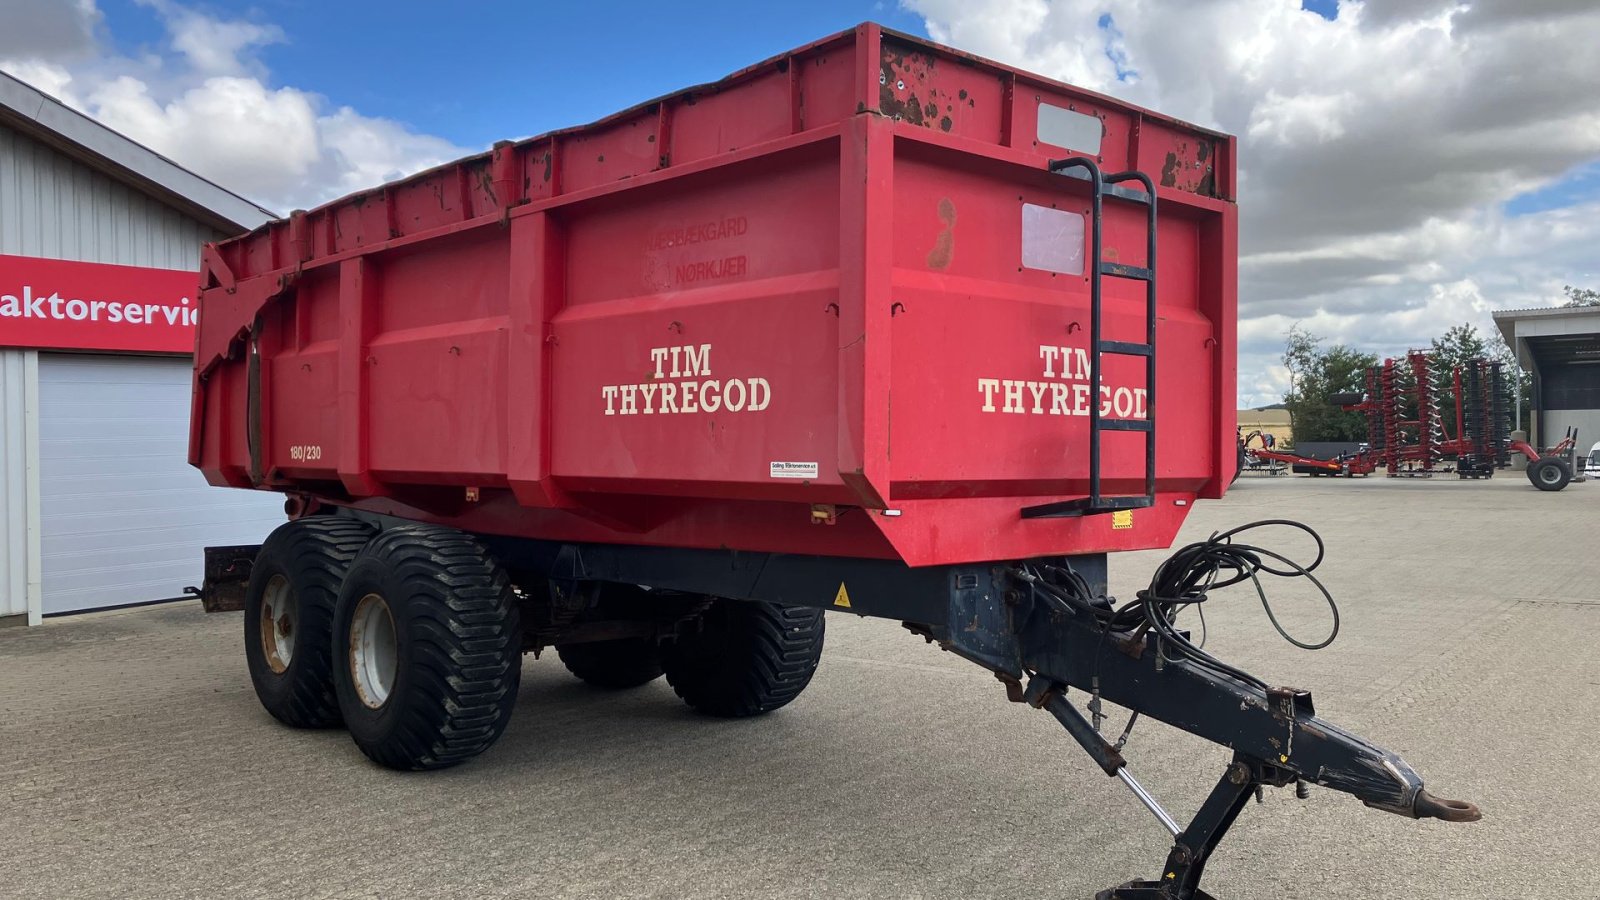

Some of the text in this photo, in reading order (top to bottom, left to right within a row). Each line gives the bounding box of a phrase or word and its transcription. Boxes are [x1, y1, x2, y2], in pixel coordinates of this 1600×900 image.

[675, 255, 748, 284] NØRKJÆR
[650, 343, 712, 379] TIM
[602, 377, 771, 415] THYREGOD
[977, 378, 1148, 419] THYREGOD
[290, 445, 321, 463] 180/230
